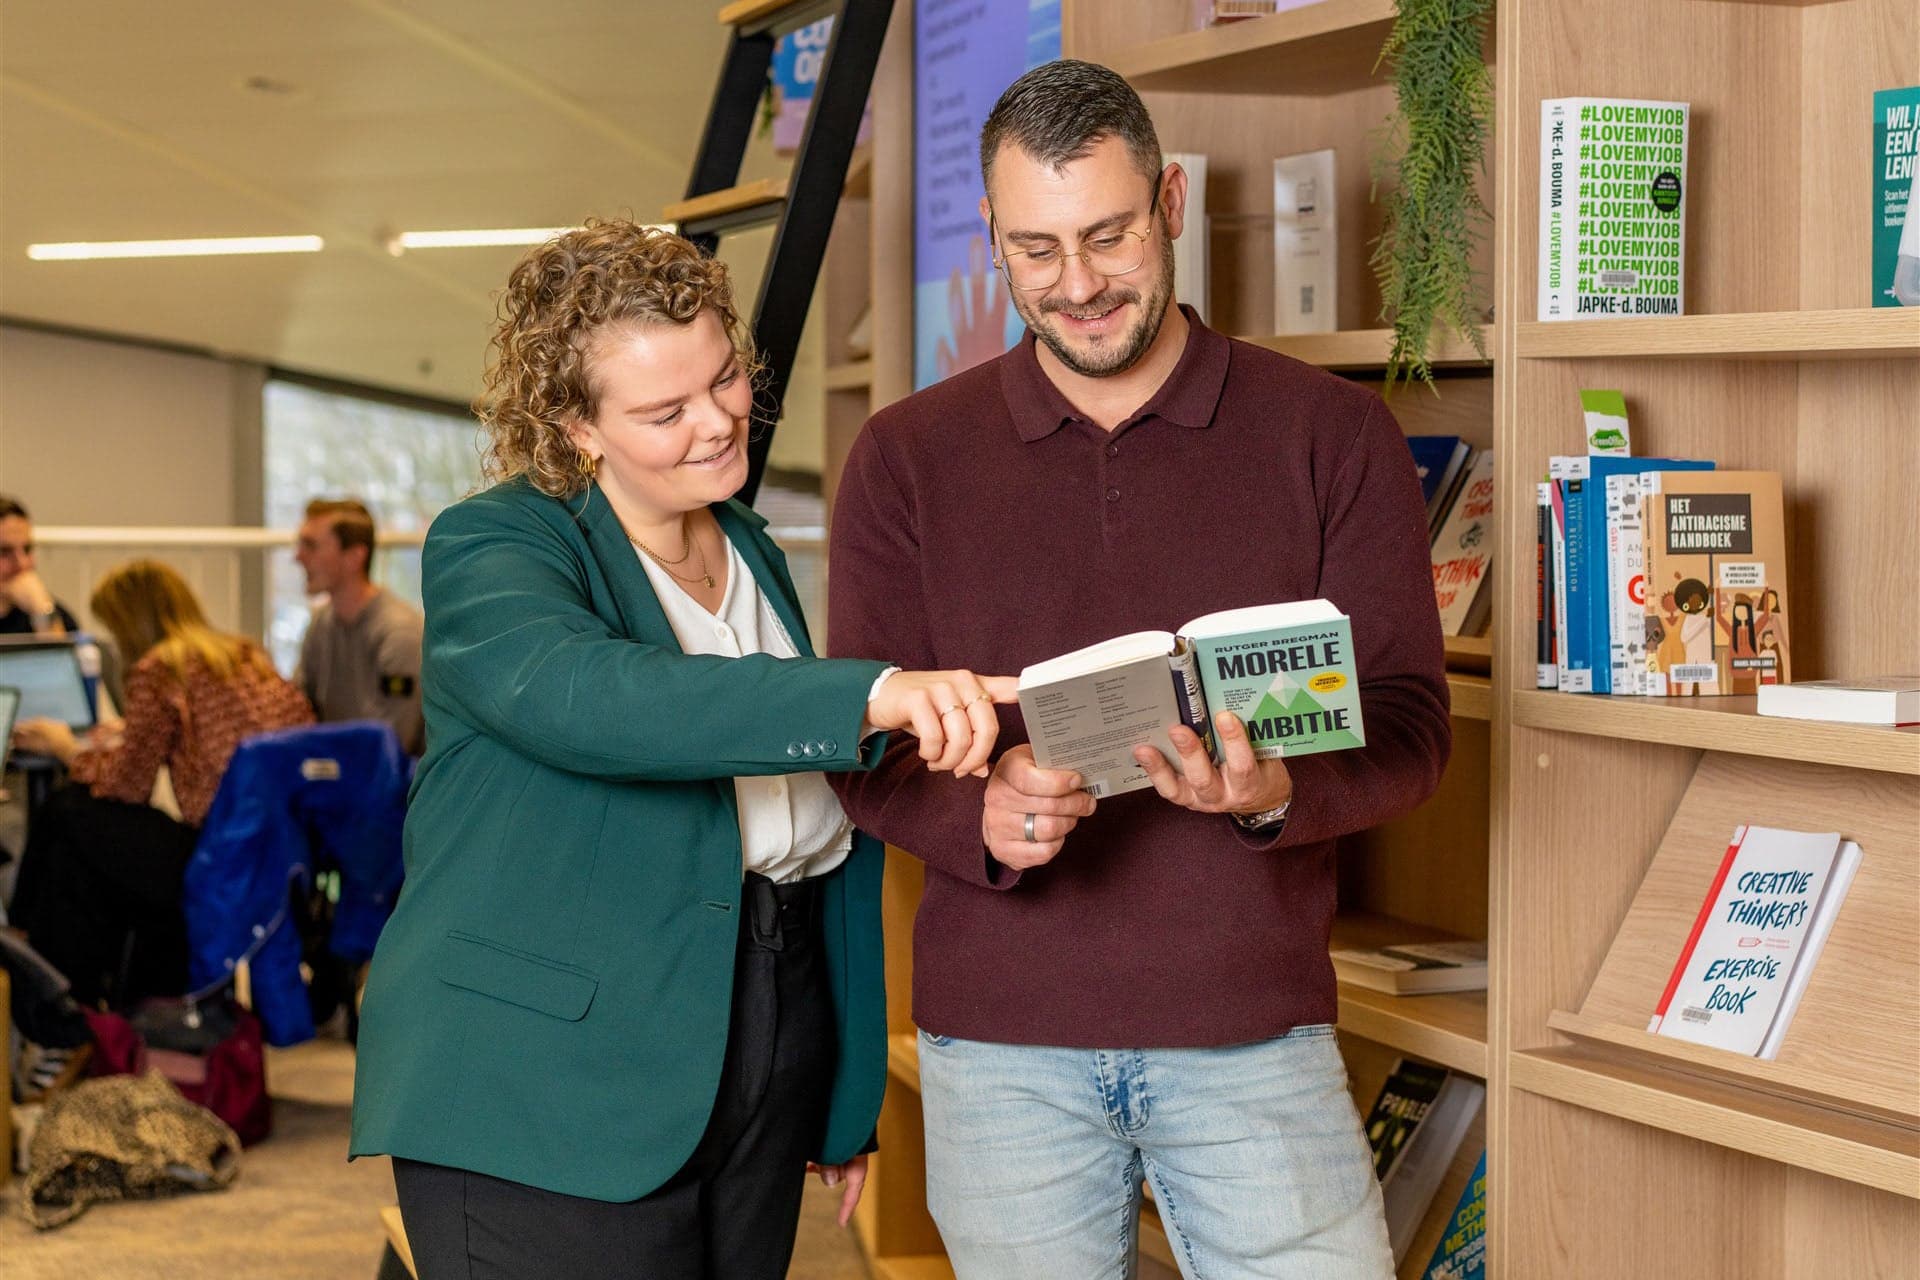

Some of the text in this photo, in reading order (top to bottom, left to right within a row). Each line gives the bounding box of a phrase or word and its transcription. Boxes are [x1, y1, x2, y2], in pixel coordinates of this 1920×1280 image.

[1581, 105, 1684, 125] #LOVEMYJOB
[1887, 104, 1920, 132] WIL J
[1580, 124, 1684, 144] #LOVEMYJOB
[1885, 130, 1913, 156] EEN
[1580, 144, 1682, 163] #LOVEMYJOB
[1551, 162, 1563, 208] BOUMA
[1578, 220, 1680, 239] #LOVEMYJOB
[1549, 212, 1562, 289] #LOVEMYJOB
[1578, 239, 1680, 258] #LOVEMYJOB
[1577, 296, 1633, 315] JAPKE-d.
[1635, 297, 1679, 315] BOUMA
[1670, 498, 1691, 514] HET
[1671, 515, 1747, 531] ANTIRACISME
[1671, 532, 1732, 548] HANDBOEK
[1215, 631, 1339, 653] RUTGER BREGMAN
[1216, 641, 1342, 681] MORELE
[1248, 708, 1350, 742] MBITIE
[1737, 870, 1814, 895] CREATIVE
[1703, 955, 1782, 982] EXERCISE
[1705, 984, 1757, 1015] BOOK
